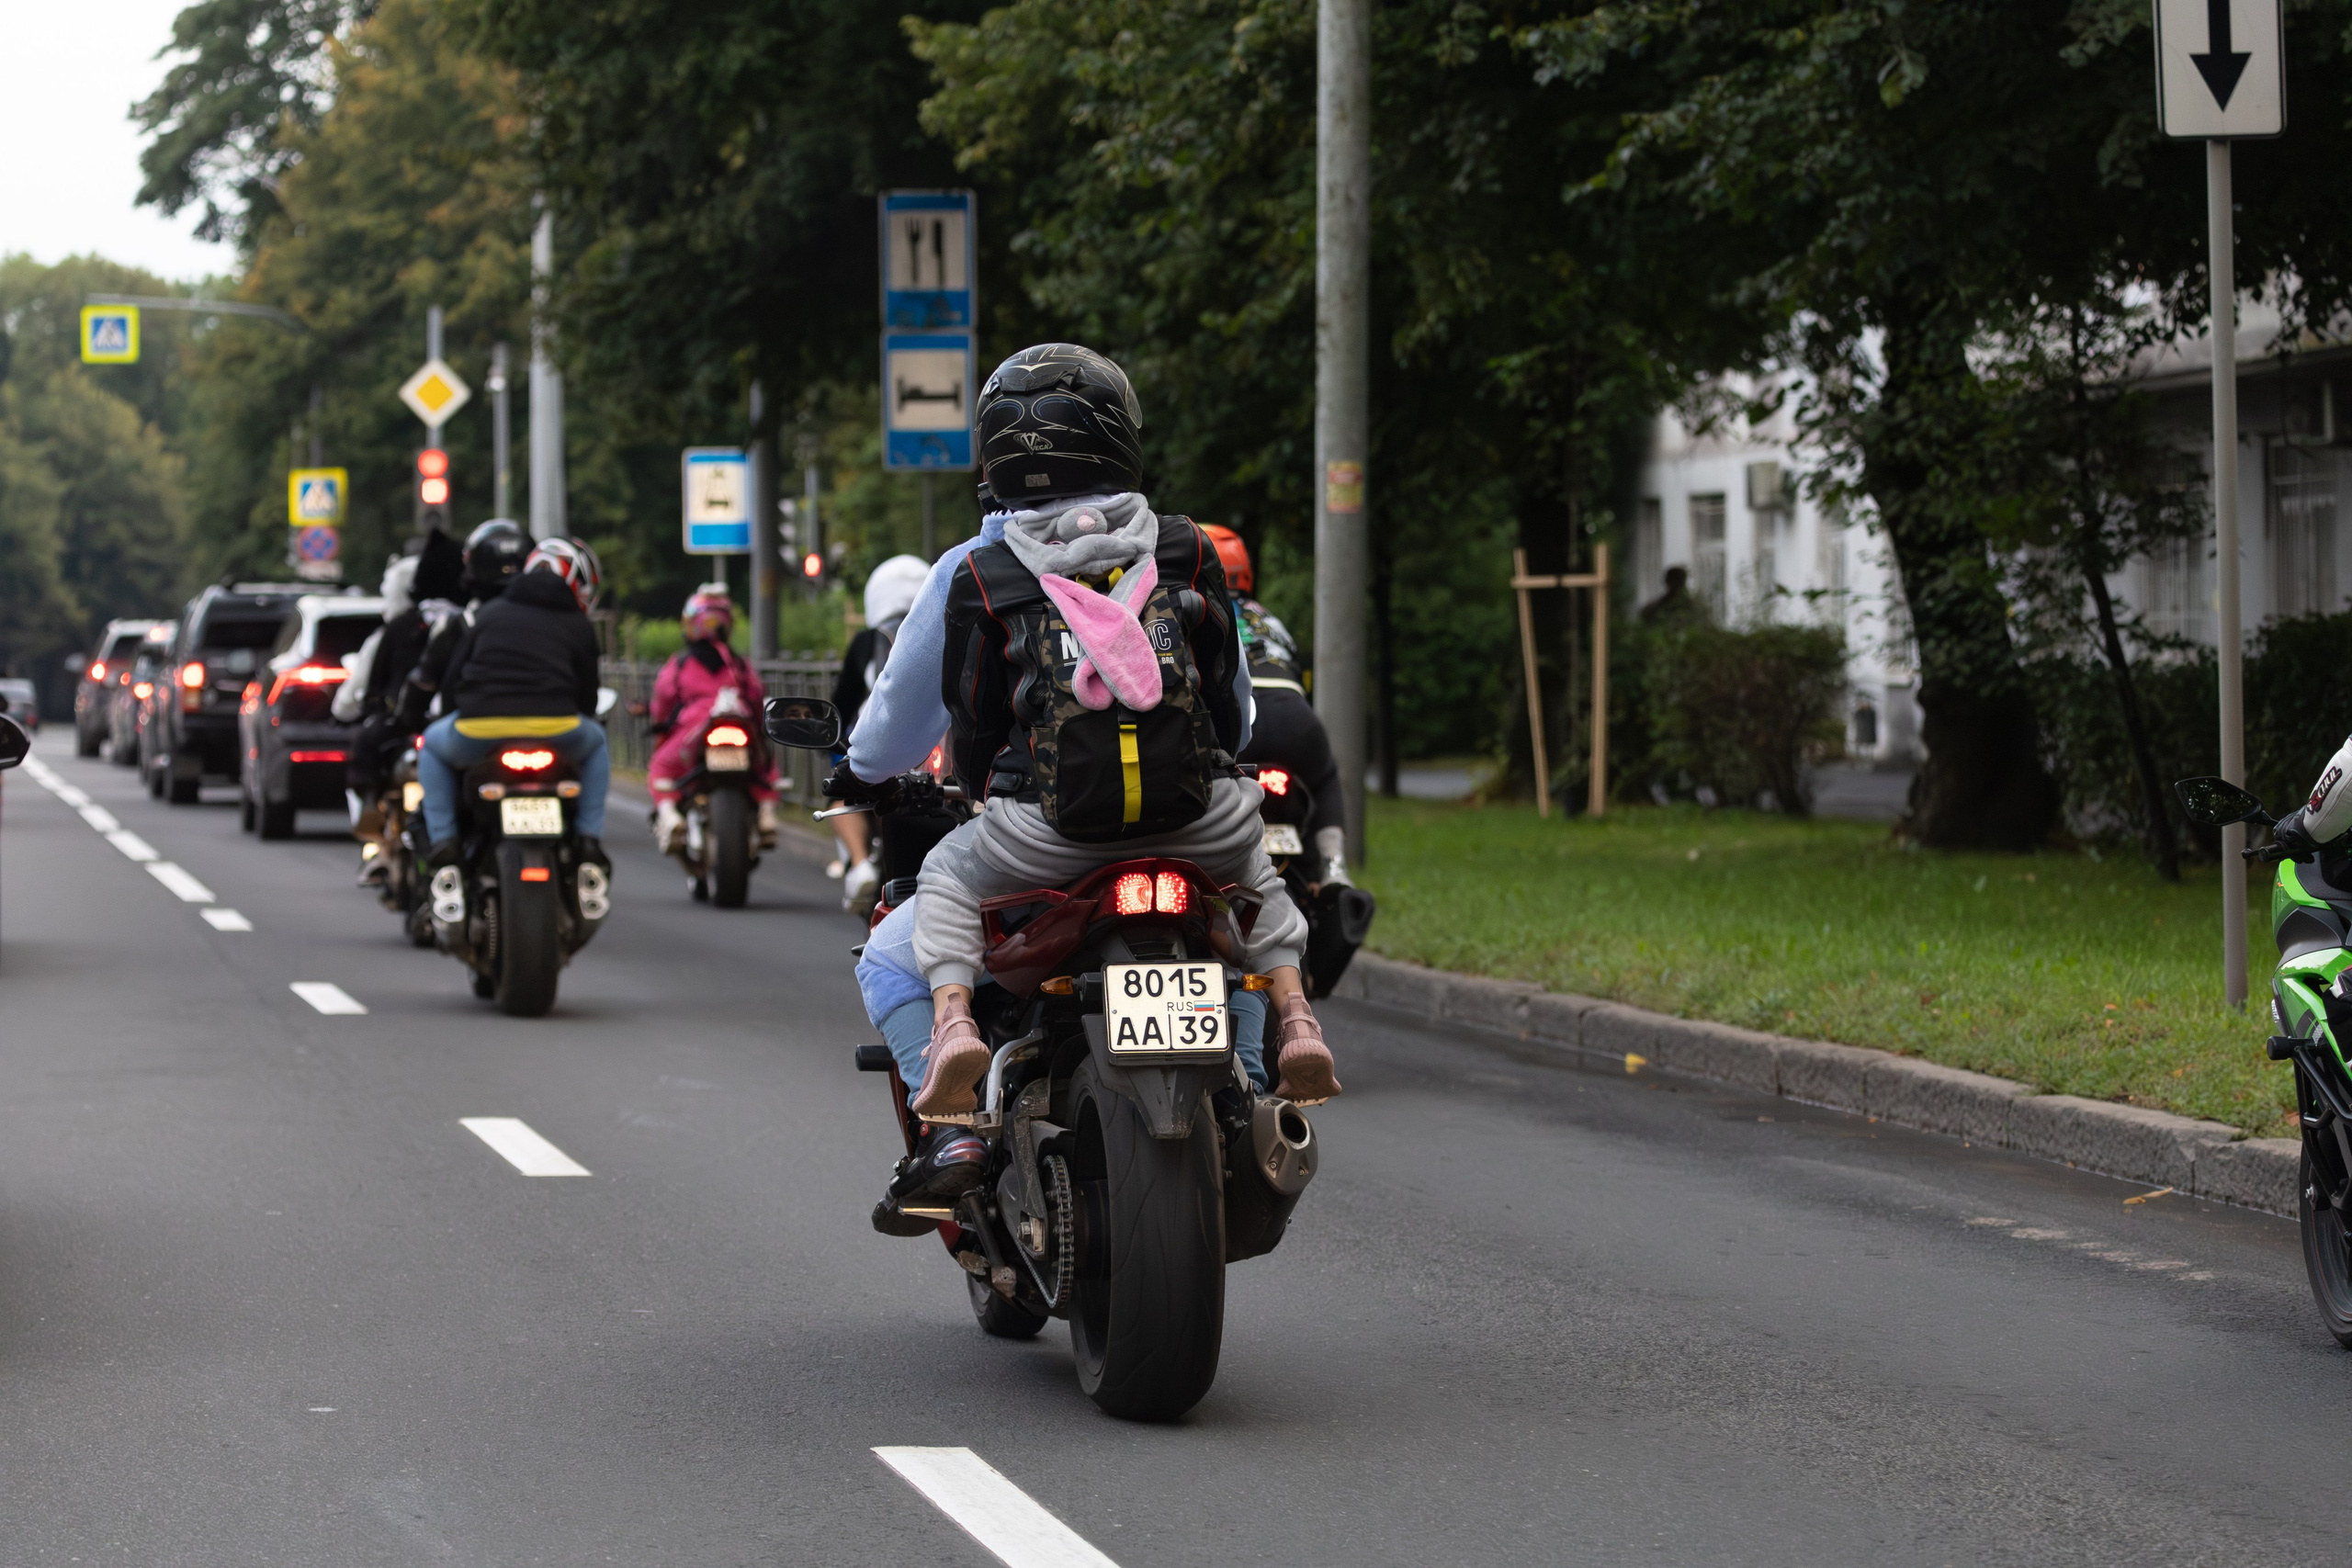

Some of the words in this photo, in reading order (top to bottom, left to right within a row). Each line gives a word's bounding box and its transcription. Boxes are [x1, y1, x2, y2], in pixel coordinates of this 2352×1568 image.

[1161, 656, 1174, 664] BRO
[1124, 967, 1206, 998] 8015
[1167, 1001, 1193, 1011] RUS
[1116, 1016, 1164, 1045] AA
[1178, 1015, 1218, 1044] 39
